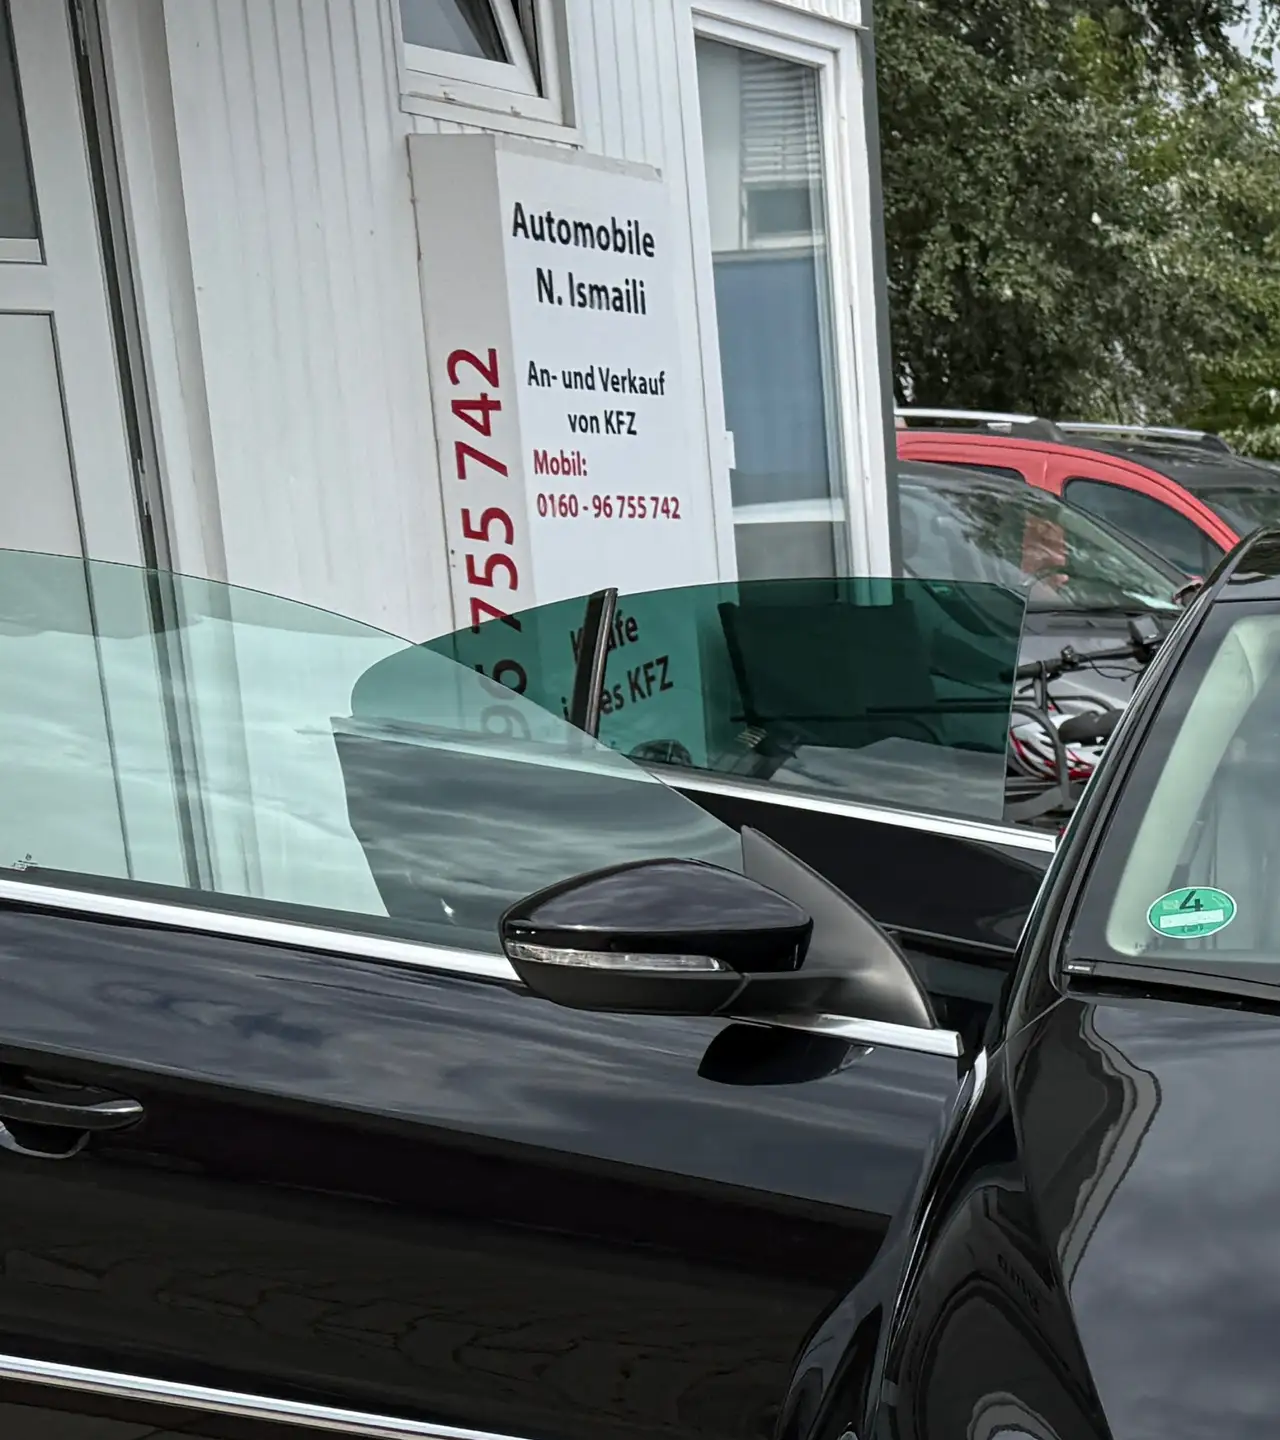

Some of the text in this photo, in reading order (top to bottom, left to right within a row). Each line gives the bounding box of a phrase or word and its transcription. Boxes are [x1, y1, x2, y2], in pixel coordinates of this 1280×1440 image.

[512, 201, 656, 258] Automobile
[536, 267, 647, 315] N. Ismaili
[527, 360, 666, 396] An- und Verkauf
[446, 347, 509, 481] 742
[567, 409, 638, 436] von KFZ
[532, 448, 588, 477] Mobil:
[536, 492, 579, 518] 0160
[592, 494, 613, 518] 96
[616, 494, 648, 519] 755
[650, 495, 682, 520] 742
[460, 506, 522, 635] 755
[626, 654, 674, 704] KFZ
[1179, 889, 1204, 912] 4
